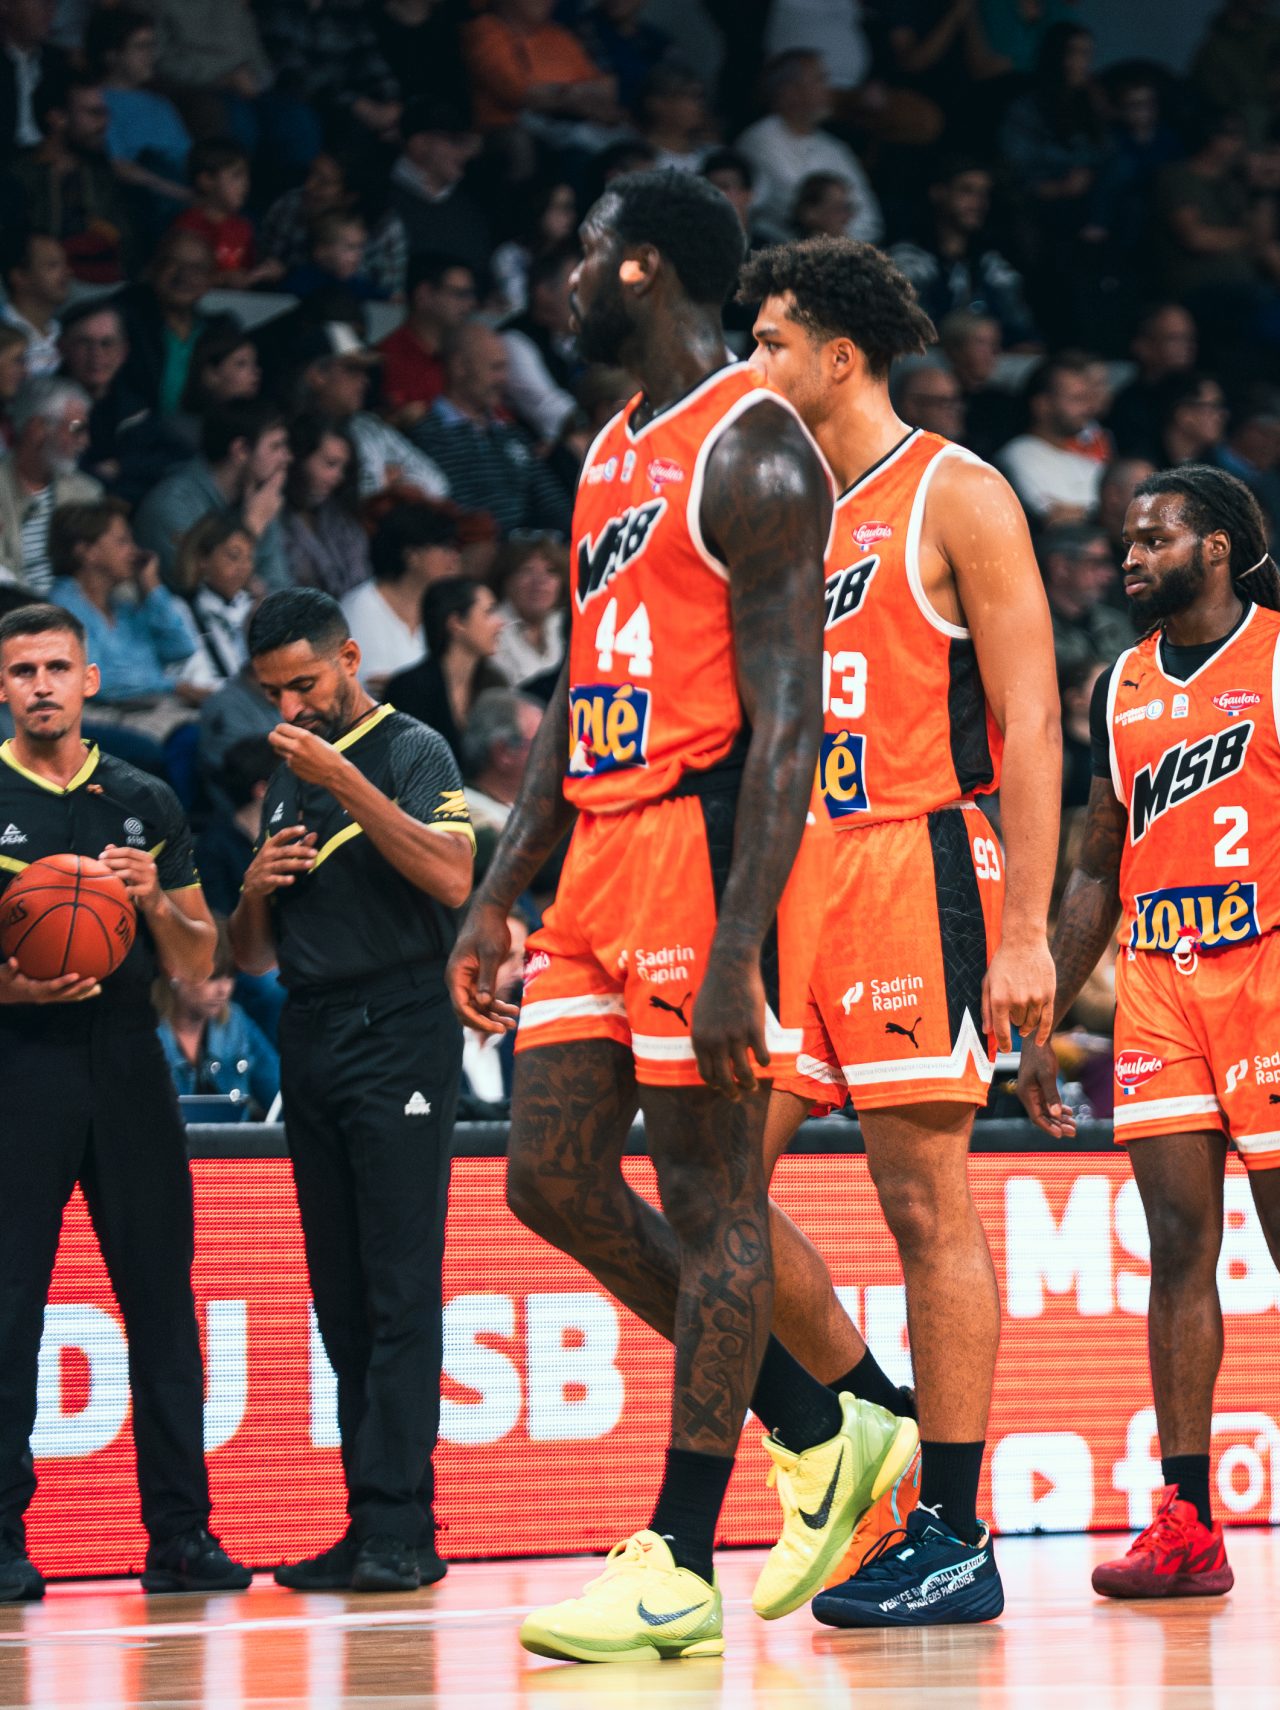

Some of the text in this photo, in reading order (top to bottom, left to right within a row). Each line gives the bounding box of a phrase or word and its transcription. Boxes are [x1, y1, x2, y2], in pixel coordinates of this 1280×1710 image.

[595, 598, 653, 677] 44
[1219, 692, 1261, 708] Gaulois
[1131, 719, 1255, 847] MSB
[1213, 805, 1250, 868] 2
[973, 837, 1001, 881] 93
[1135, 881, 1251, 950] Loué
[635, 944, 695, 967] Sadrin
[870, 973, 924, 996] Sadrin
[872, 991, 918, 1012] Rapin
[309, 1291, 626, 1449] SB
[911, 1570, 957, 1597] BAKETBALL
